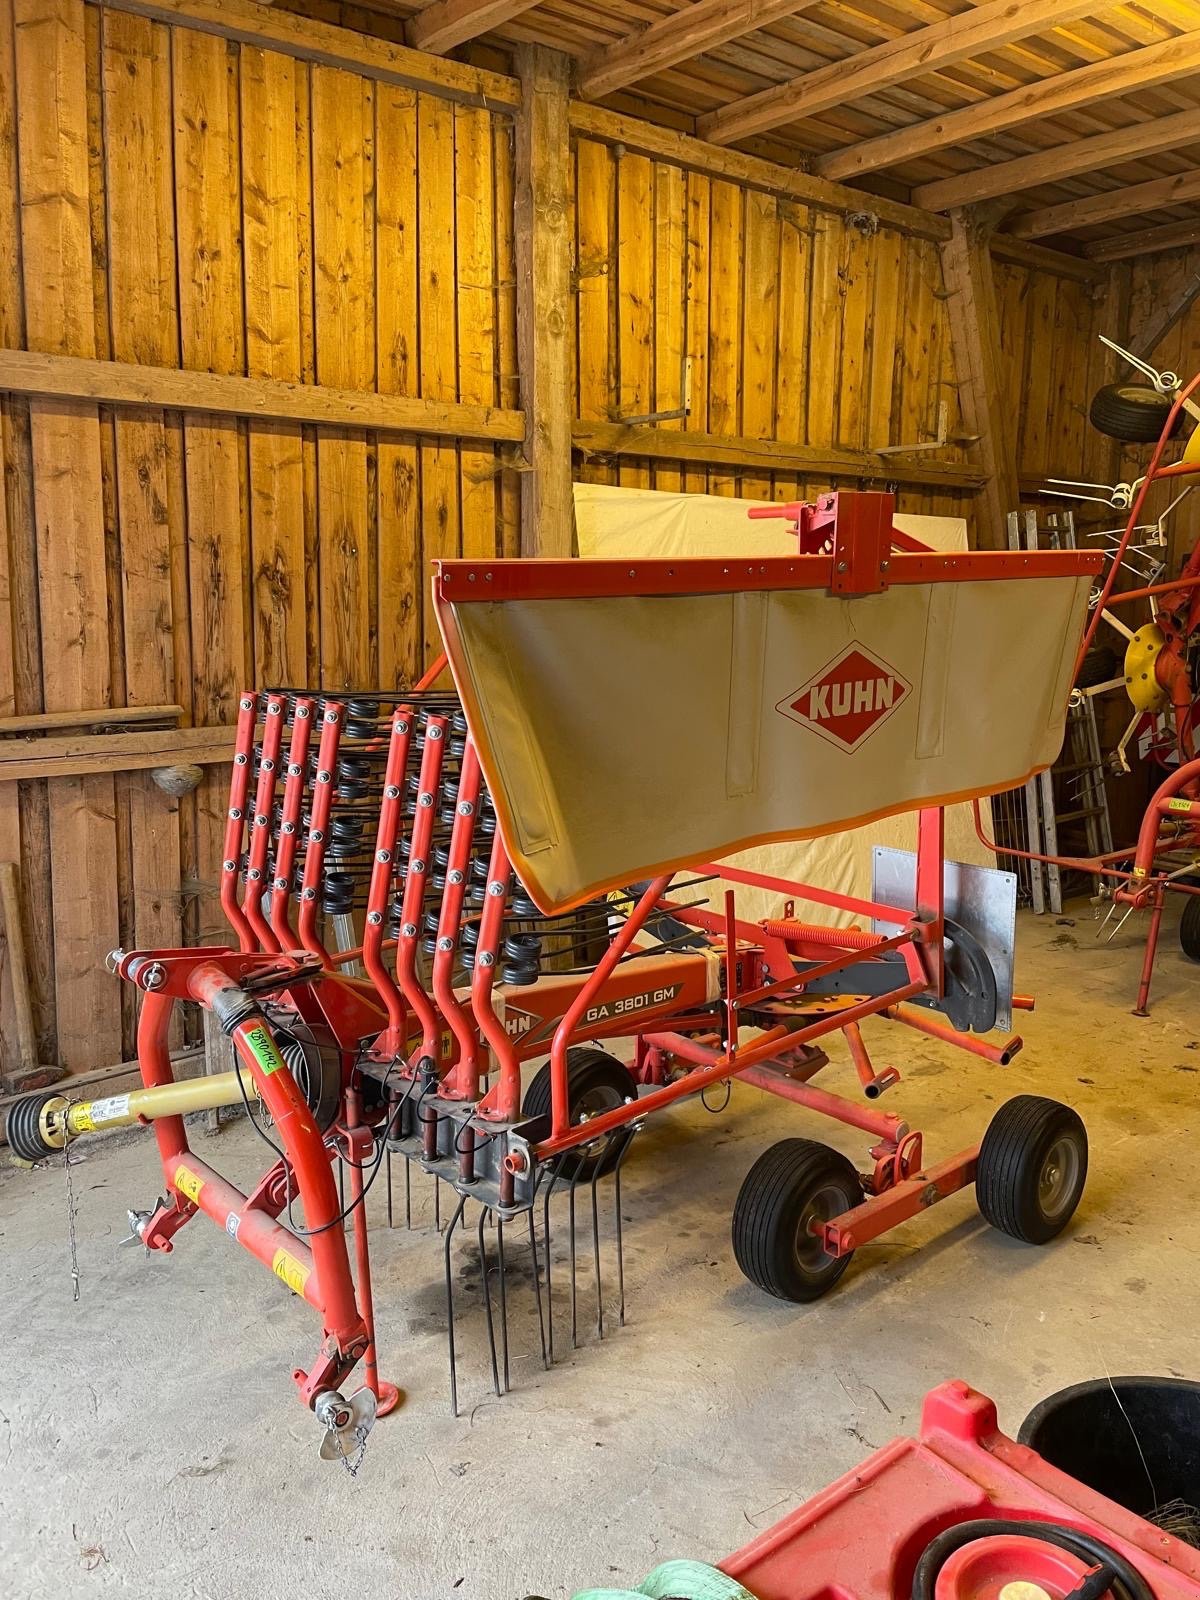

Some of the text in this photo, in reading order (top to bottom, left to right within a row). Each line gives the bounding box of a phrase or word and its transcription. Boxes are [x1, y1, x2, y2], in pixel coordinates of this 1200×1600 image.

[809, 677, 895, 721] KUHN
[587, 987, 674, 1021] GA 3801 GM
